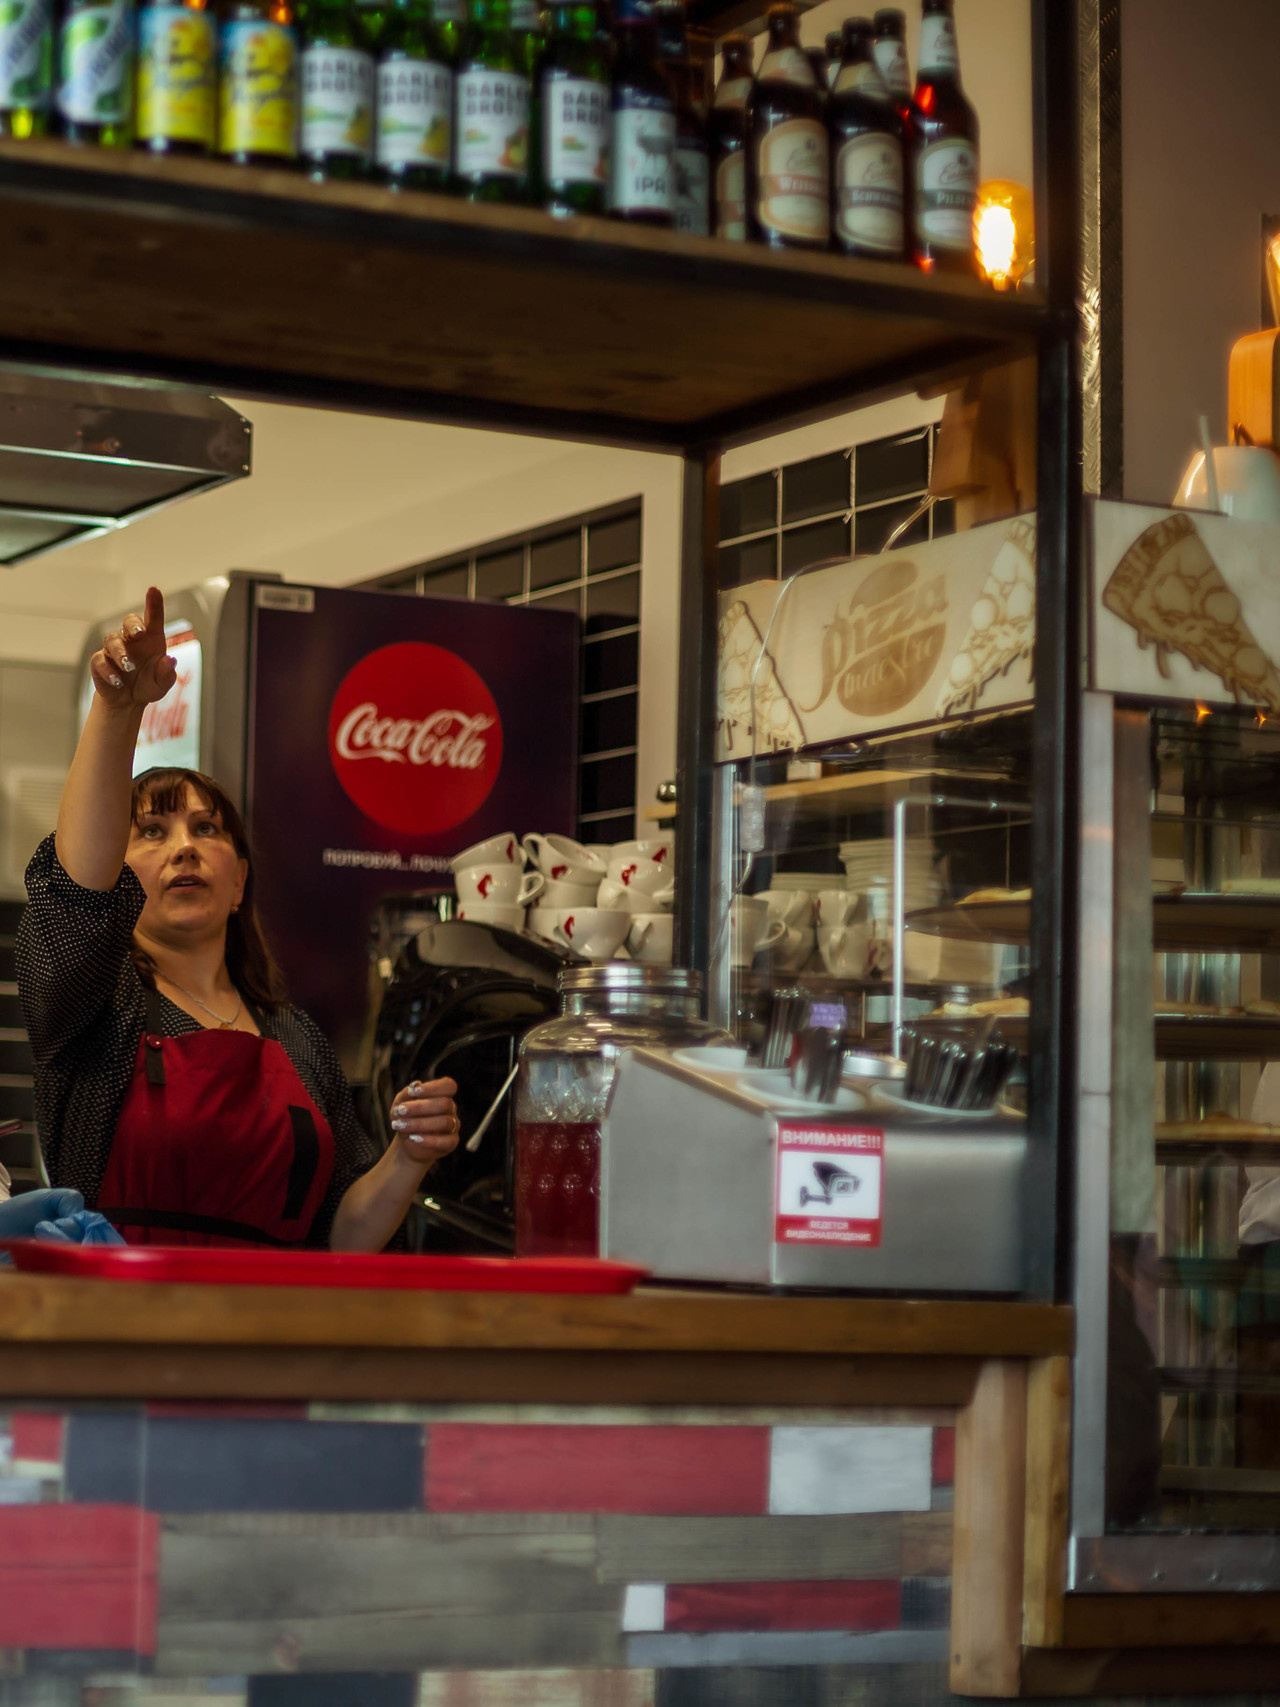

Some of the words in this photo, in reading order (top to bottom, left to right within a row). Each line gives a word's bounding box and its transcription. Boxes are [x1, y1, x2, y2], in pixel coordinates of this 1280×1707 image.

[634, 176, 667, 194] IPA
[782, 1130, 881, 1149] ВНИМАНИЕ!!!
[785, 1229, 872, 1242] ВИДЕОНАБЛЮДЕНИЕ
